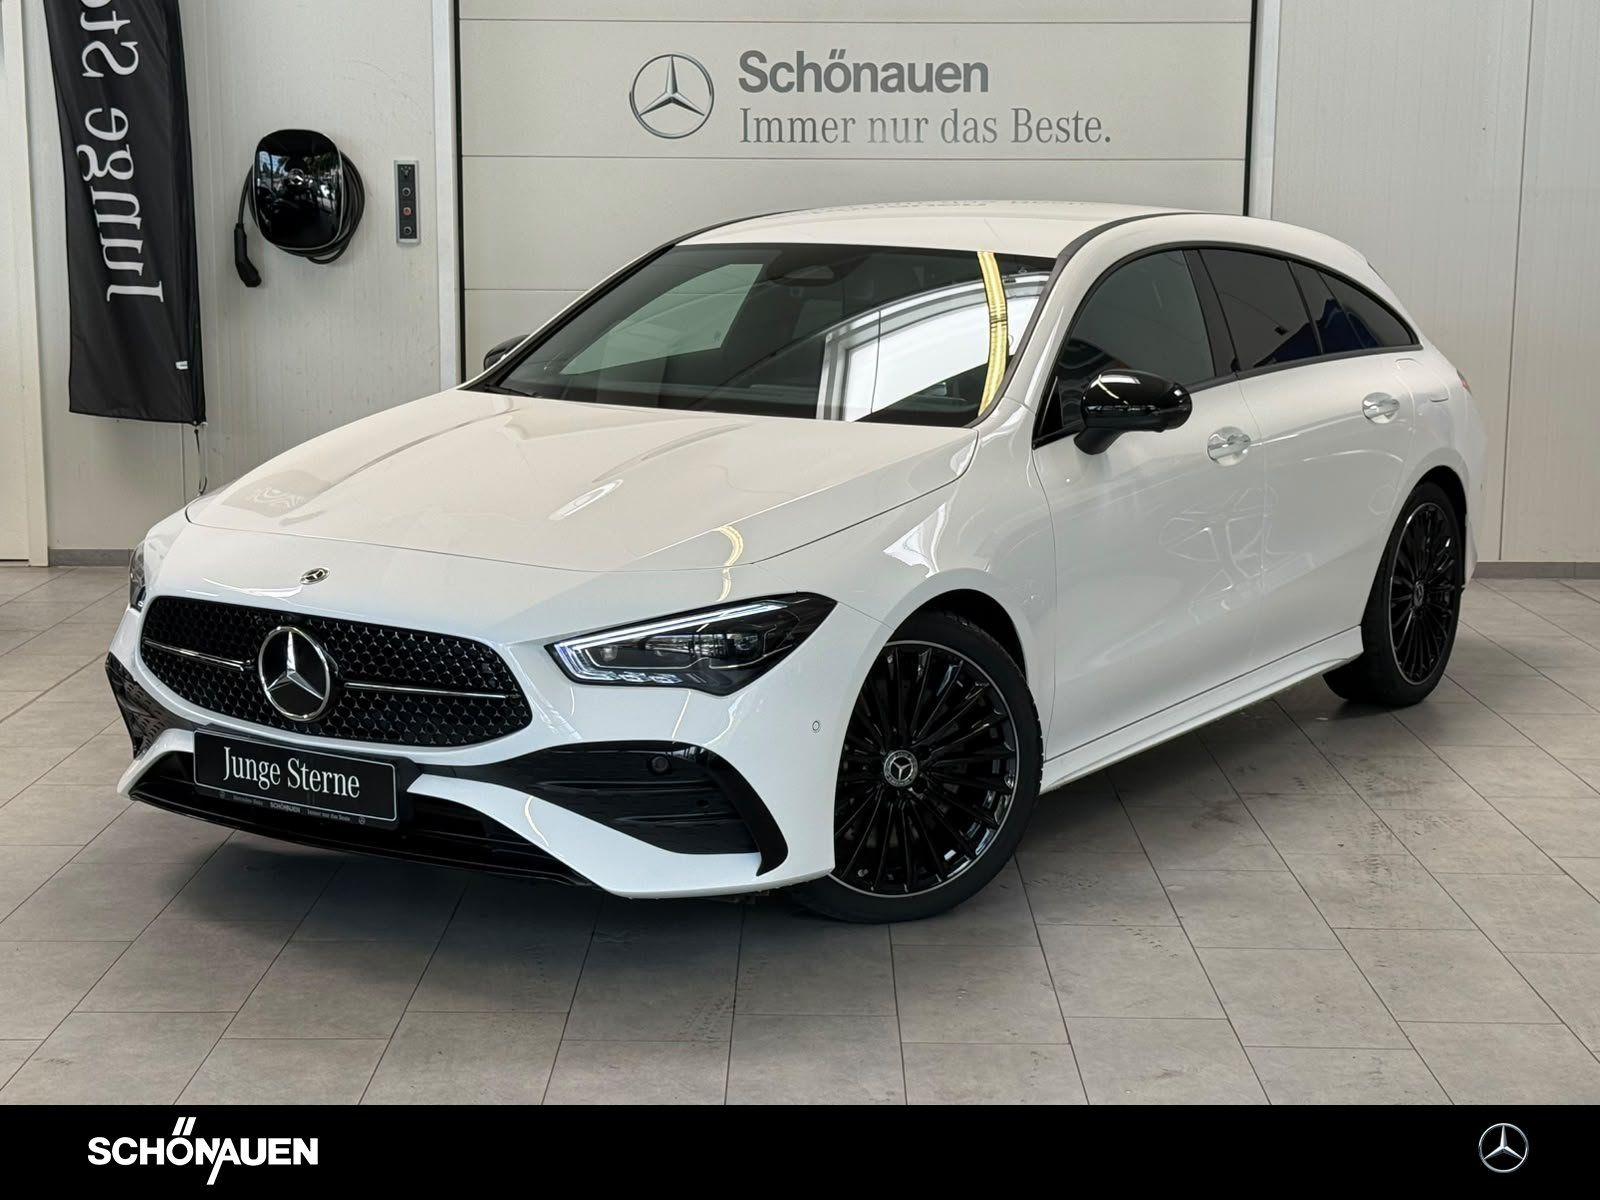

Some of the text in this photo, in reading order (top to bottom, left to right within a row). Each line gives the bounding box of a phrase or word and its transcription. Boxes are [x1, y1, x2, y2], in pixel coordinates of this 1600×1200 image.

[738, 48, 989, 94] Schönauen
[739, 107, 1111, 144] Immer nur das Beste.
[223, 746, 360, 798] Junge Sterne
